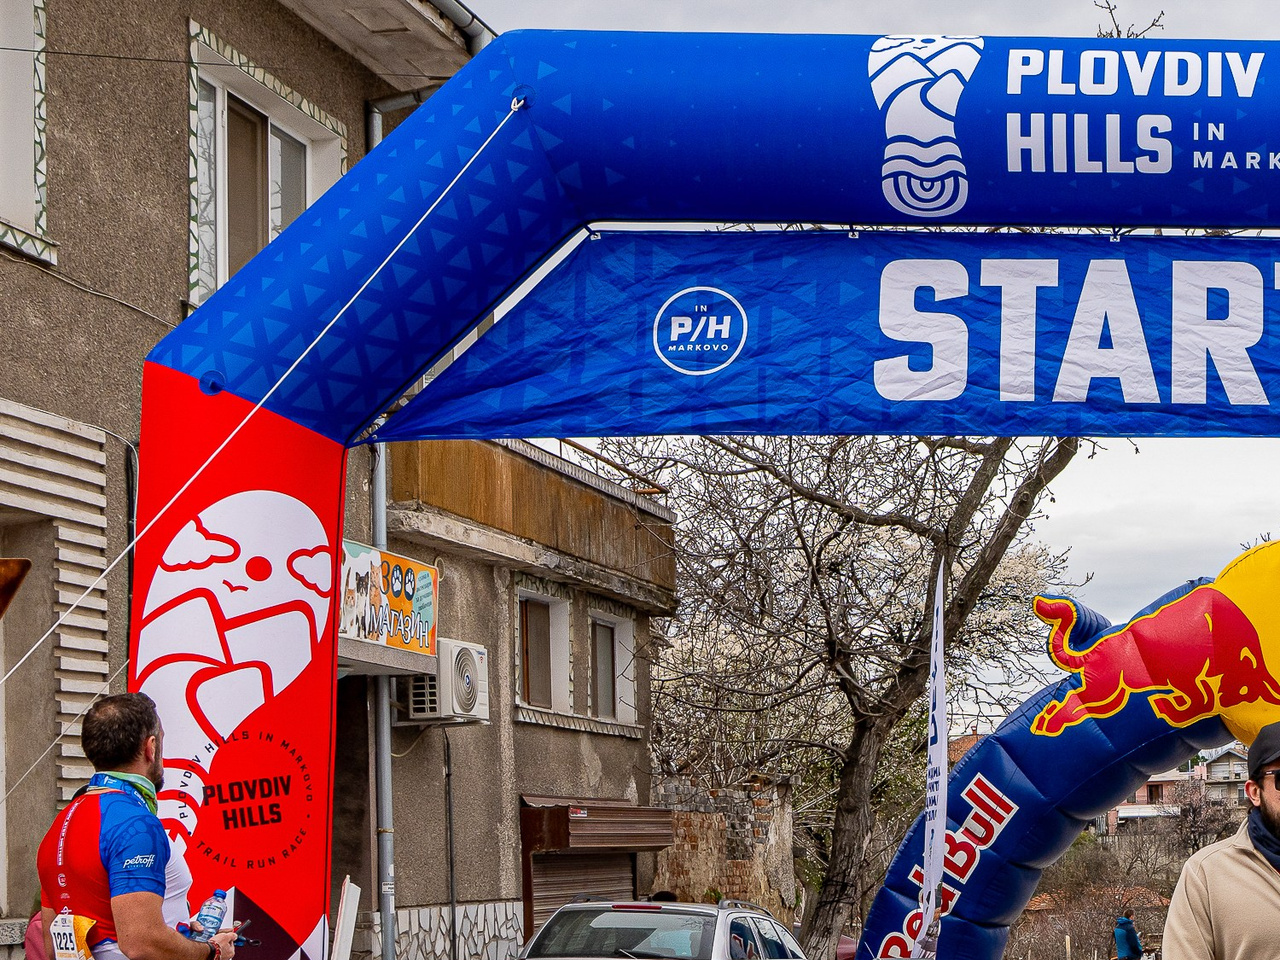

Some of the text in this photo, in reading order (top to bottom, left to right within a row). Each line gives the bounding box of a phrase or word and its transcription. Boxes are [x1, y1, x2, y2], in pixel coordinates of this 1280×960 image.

[1006, 49, 1266, 98] PLOVDIV
[1005, 112, 1173, 174] HILLS
[1193, 122, 1225, 141] IN
[694, 304, 708, 313] IN
[670, 315, 732, 342] P/H
[667, 343, 729, 352] MARKOVO
[368, 603, 430, 649] МАГАЗИН
[178, 730, 313, 820] PLOVDIV HILLS IN MARKOVO
[202, 774, 292, 807] PLOVDIV
[221, 802, 283, 831] HILLS
[943, 771, 1020, 885] Bull
[196, 827, 308, 869] TRAIL RUN RACE
[53, 932, 75, 950] 1225
